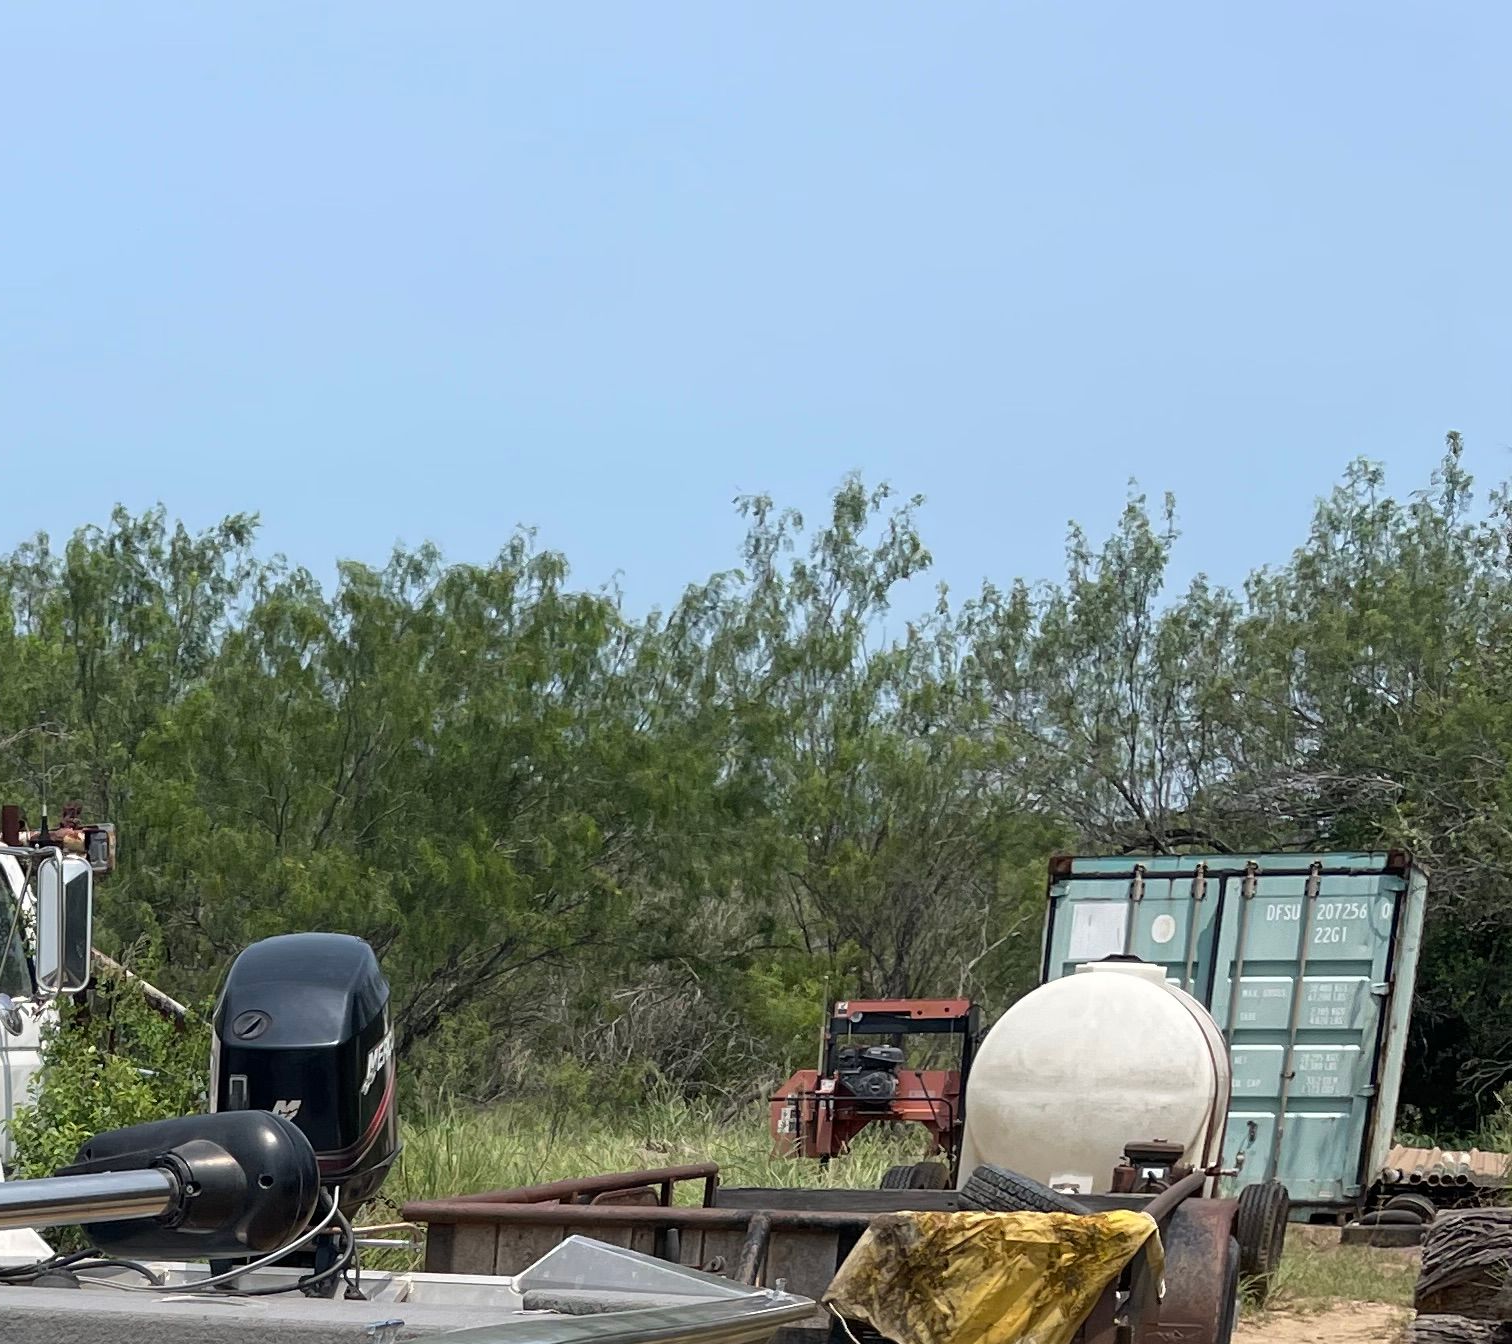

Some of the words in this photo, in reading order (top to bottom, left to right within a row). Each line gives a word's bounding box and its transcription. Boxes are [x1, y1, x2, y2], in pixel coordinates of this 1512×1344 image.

[1266, 904, 1301, 921] DFSU
[1316, 903, 1368, 920] 207256
[1313, 926, 1348, 943] 22G1
